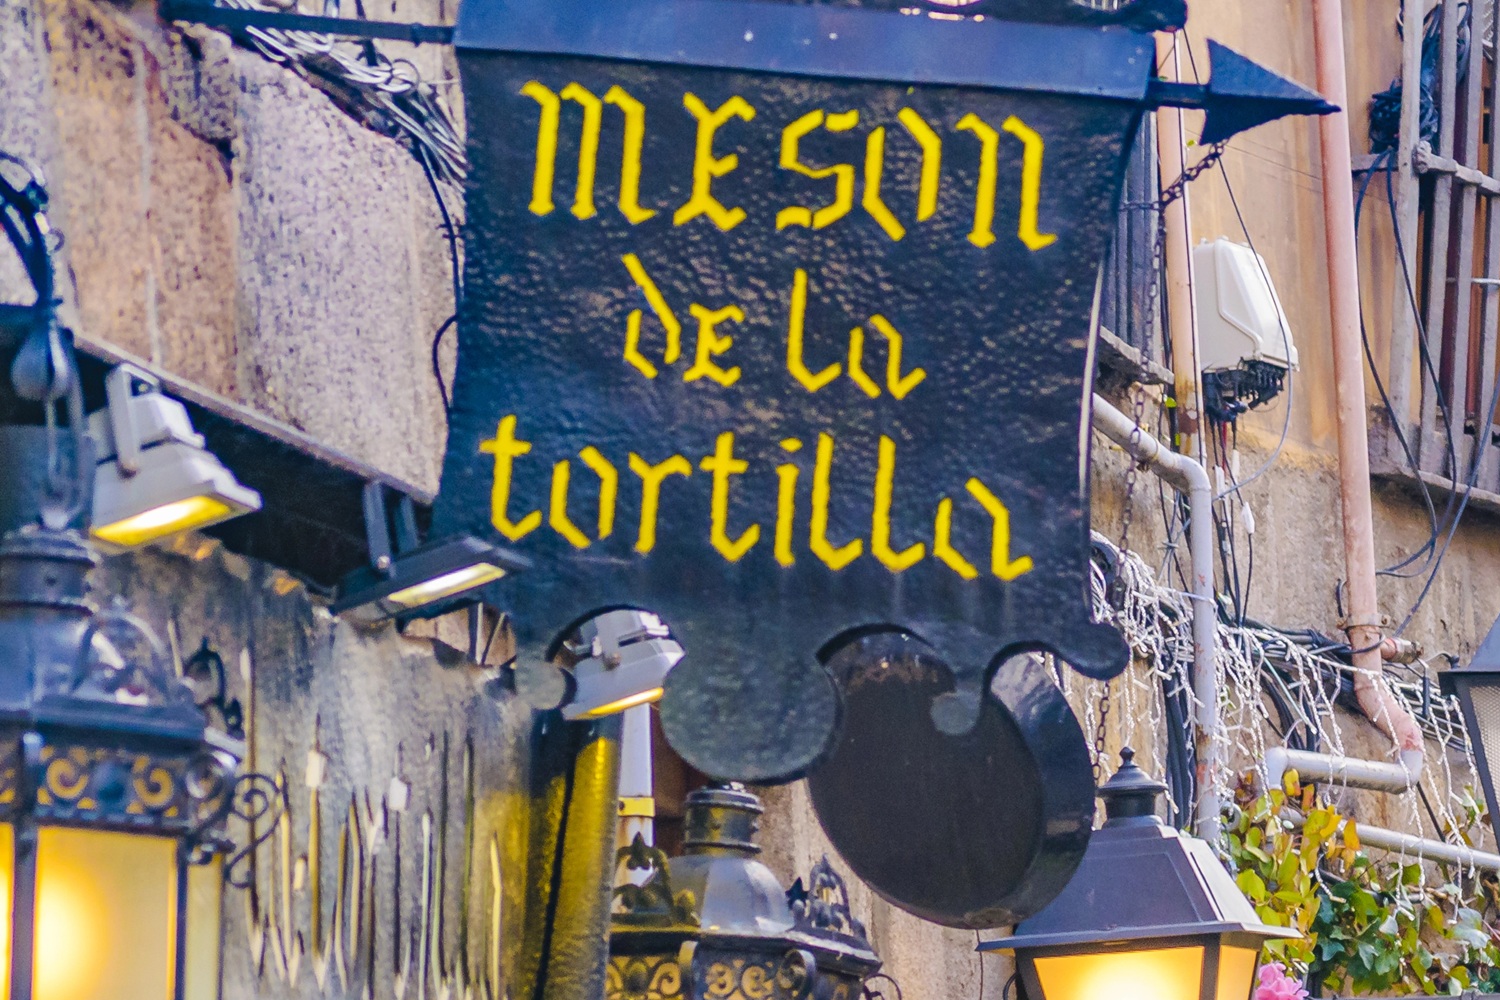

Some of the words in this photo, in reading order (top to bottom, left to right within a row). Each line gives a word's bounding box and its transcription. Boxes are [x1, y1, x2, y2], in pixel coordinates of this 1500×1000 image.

[521, 81, 1057, 252] MESON
[786, 268, 927, 399] la
[479, 414, 1034, 582] tortilla
